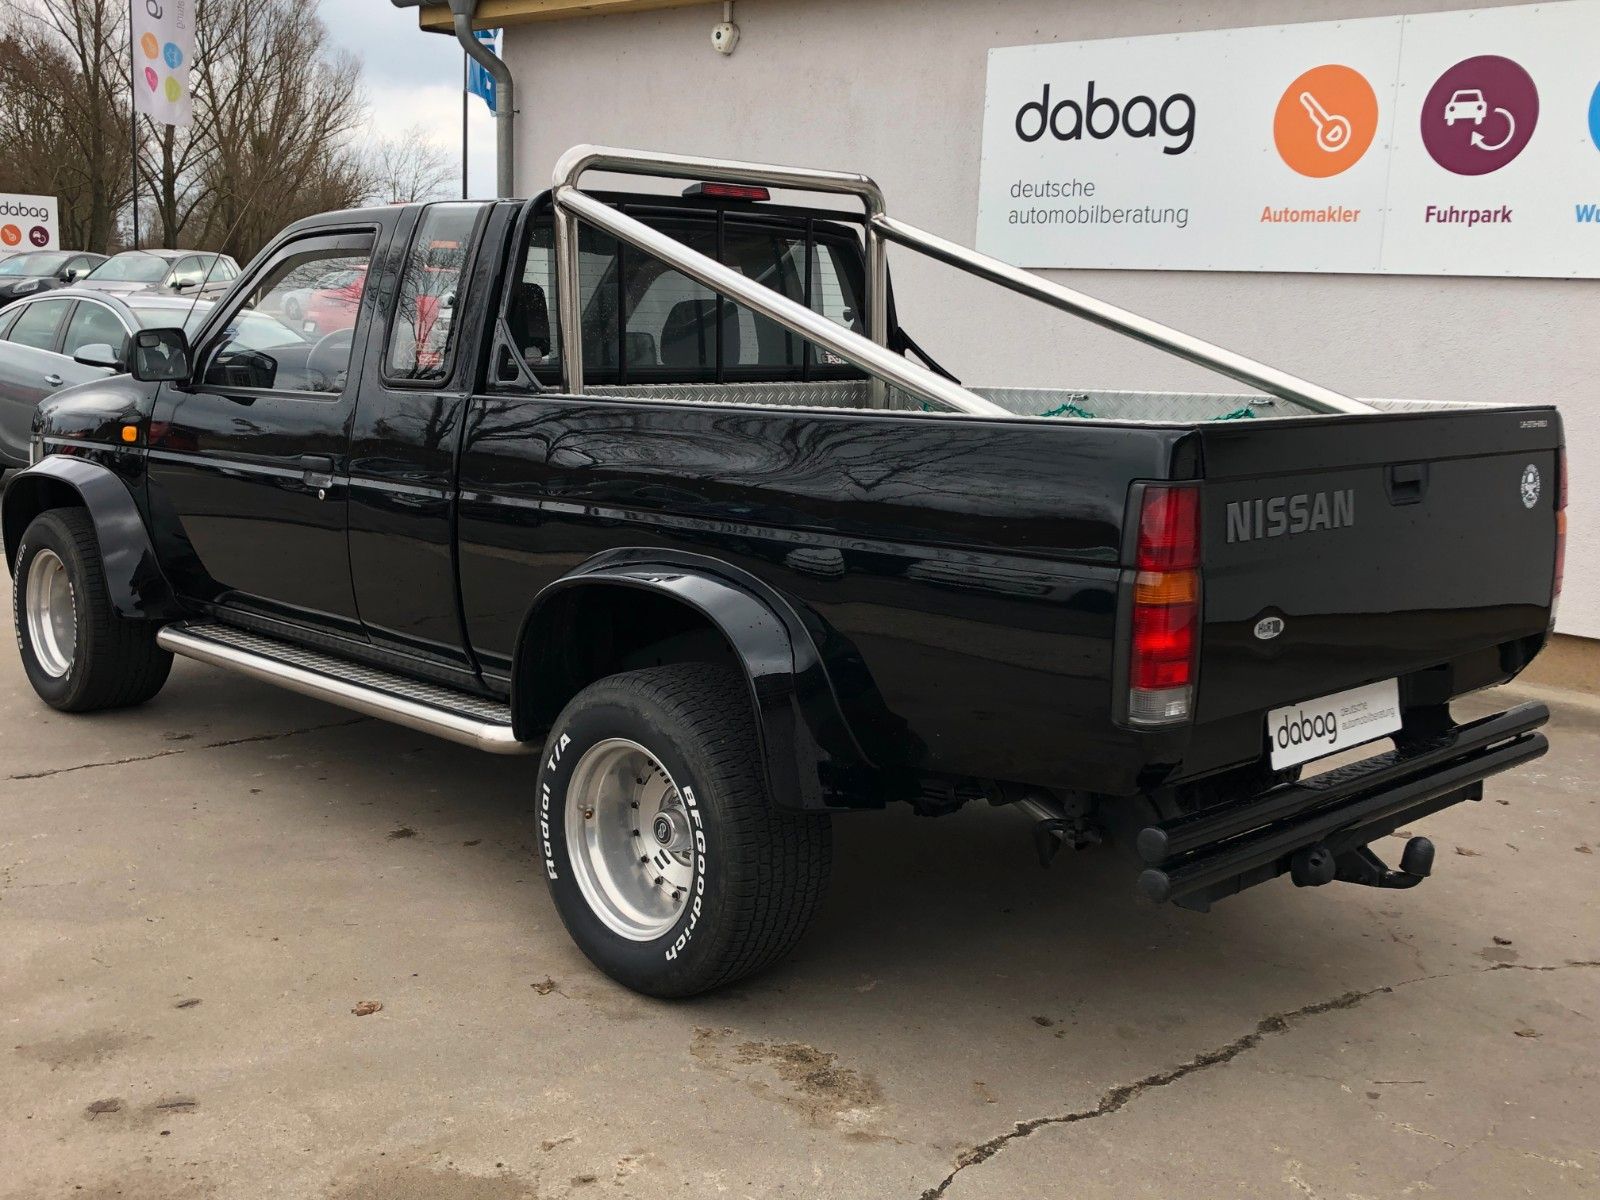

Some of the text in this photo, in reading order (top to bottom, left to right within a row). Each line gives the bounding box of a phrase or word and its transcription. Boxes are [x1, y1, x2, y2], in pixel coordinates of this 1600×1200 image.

[1015, 80, 1196, 155] dabag
[1010, 178, 1096, 198] deutsche
[0, 201, 49, 222] dabag
[1008, 205, 1189, 229] automobilberatung
[1260, 205, 1361, 224] Automakler
[1424, 205, 1513, 228] Fuhrpark
[1226, 489, 1354, 543] NISSAN
[1277, 710, 1338, 750] dabag
[540, 732, 571, 880] Radial T/A
[665, 785, 707, 961] BFGoodrich
